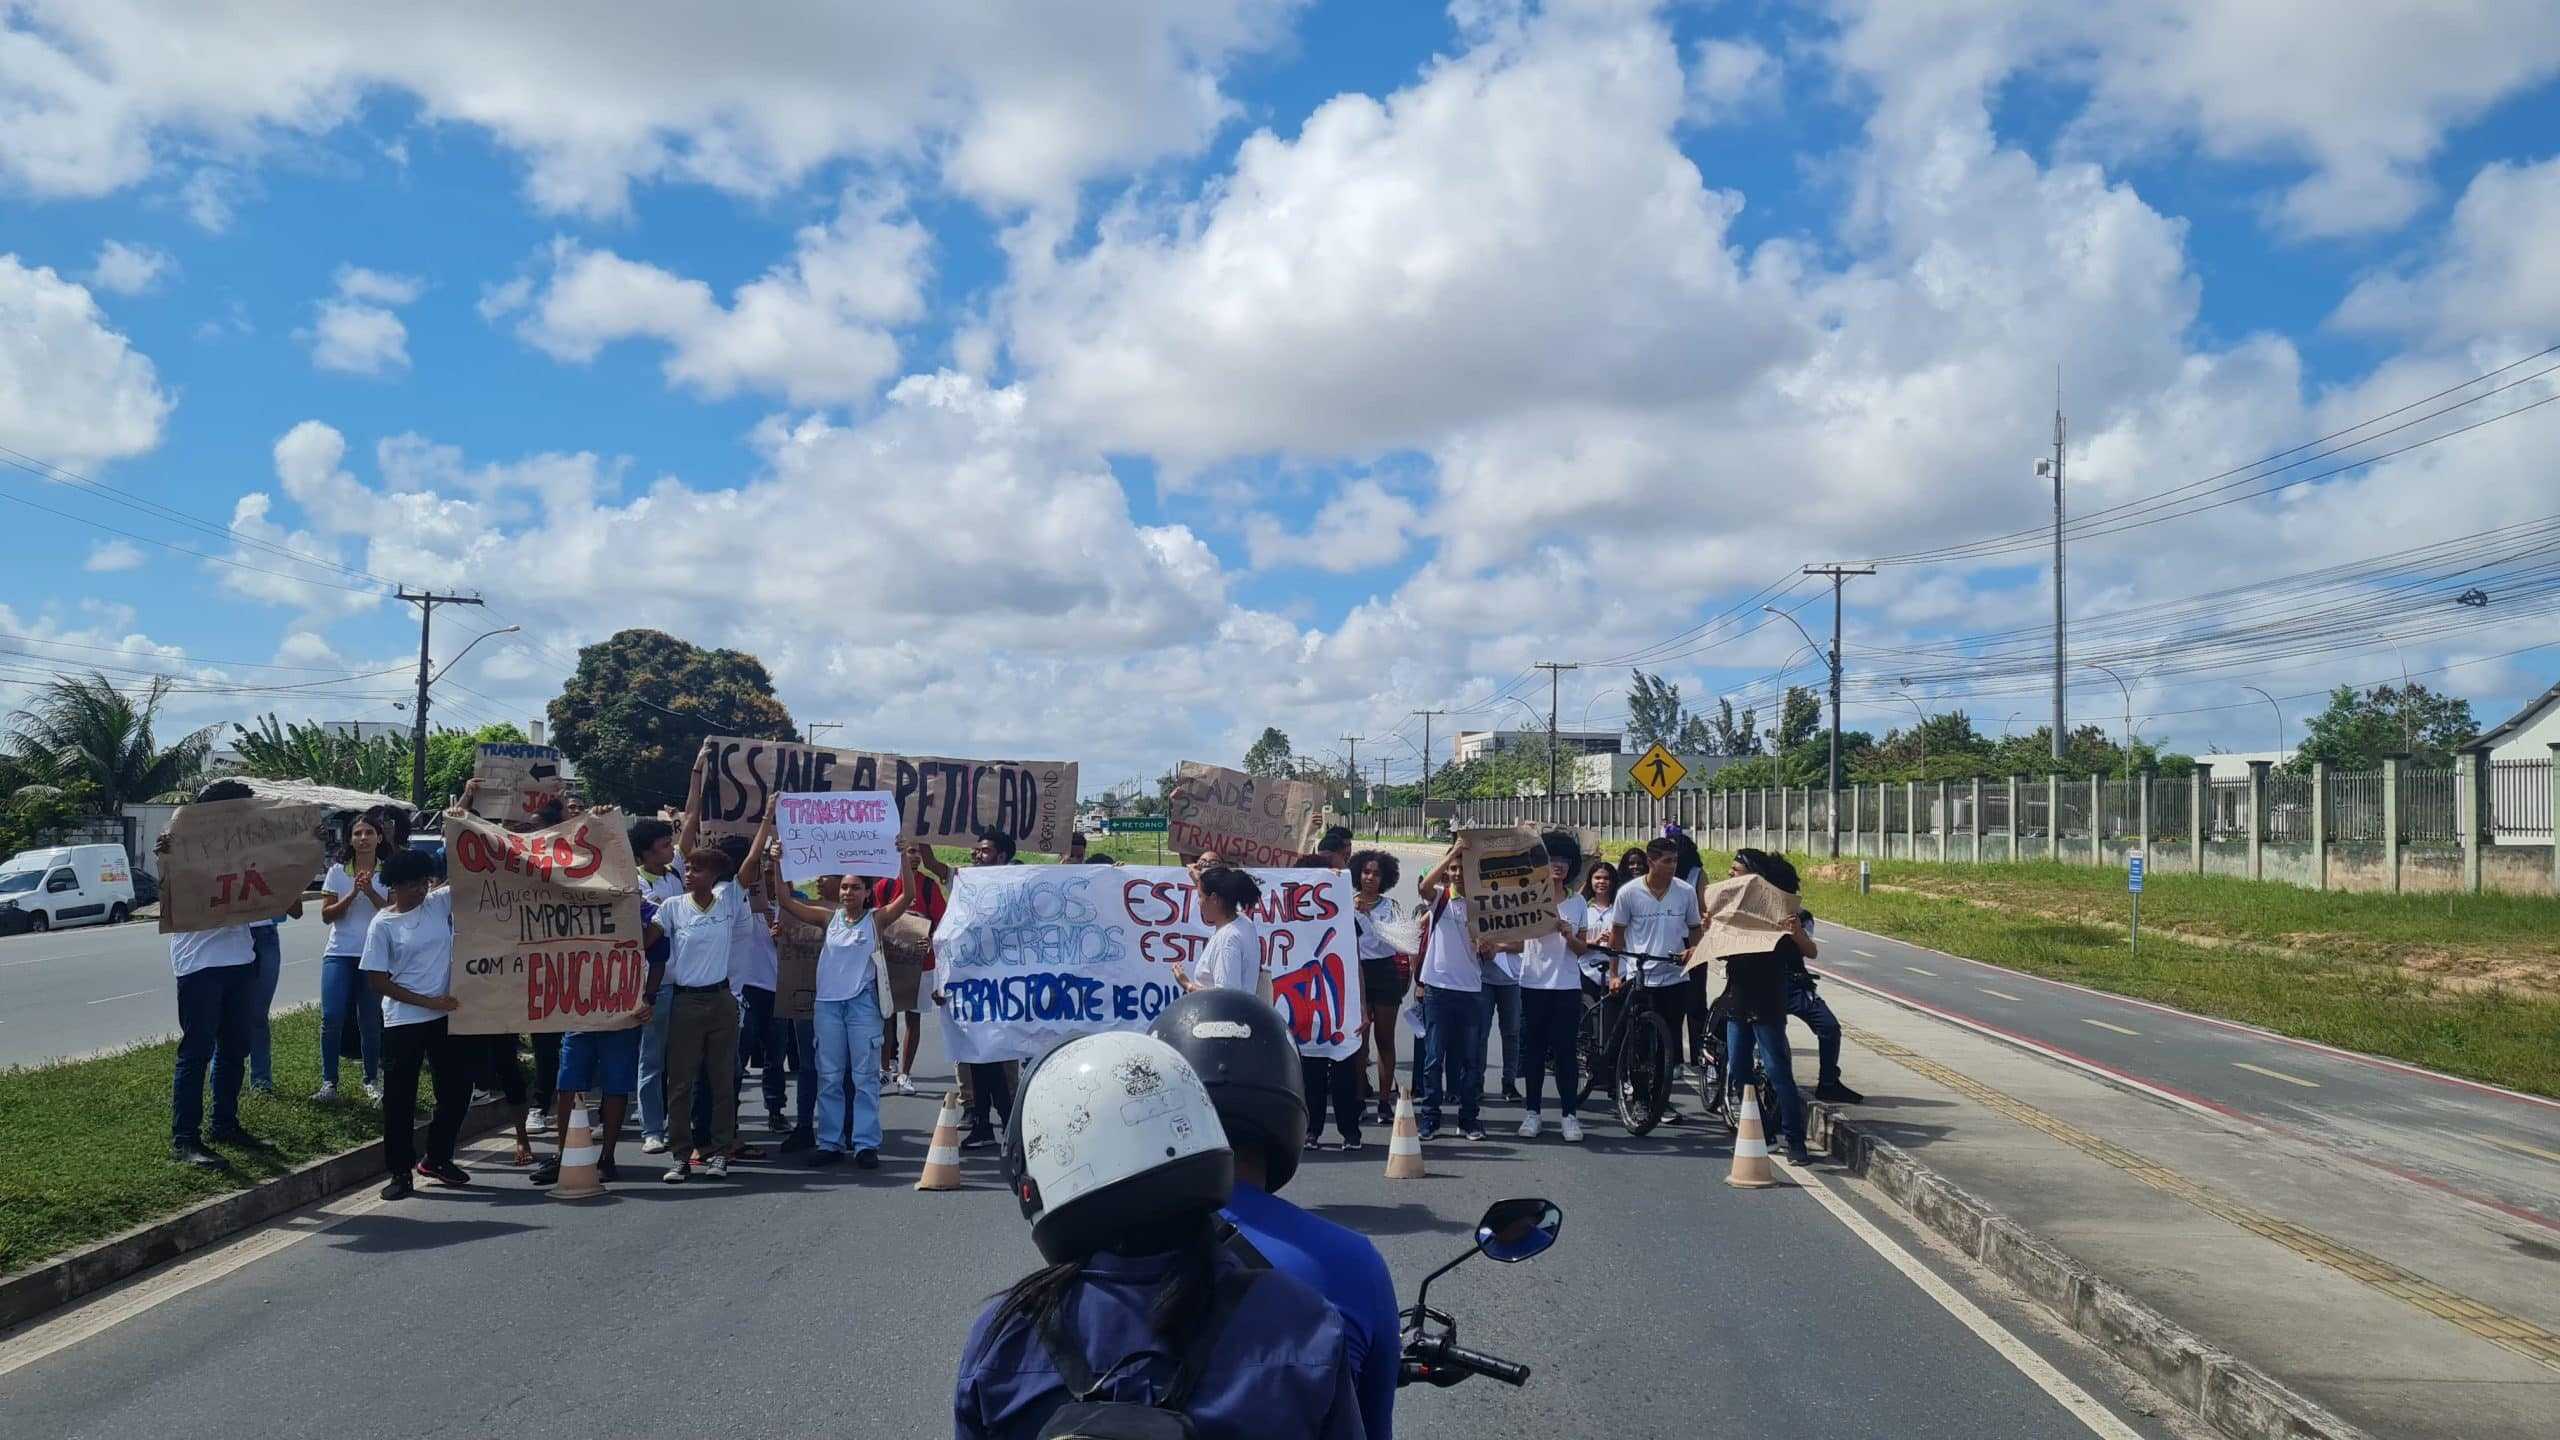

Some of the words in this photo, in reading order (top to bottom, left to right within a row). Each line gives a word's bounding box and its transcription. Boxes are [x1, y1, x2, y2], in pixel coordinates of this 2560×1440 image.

[480, 744, 559, 761] TRANSPORTE
[702, 742, 836, 825] ASSINE
[852, 757, 877, 791] A
[781, 798, 887, 824] TRANSPORTE
[1122, 821, 1164, 829] RETORNO
[787, 828, 803, 840] DE
[810, 827, 880, 845] QUALIDADE
[789, 844, 822, 865] JÁ!
[210, 863, 273, 908] JÁ
[952, 877, 1097, 925] SOMOS
[1474, 890, 1538, 911] TEMOS
[520, 903, 615, 941] IMPORTE
[946, 923, 1126, 968] QUEREMOS
[466, 957, 503, 975] COM
[513, 956, 524, 973] A
[528, 940, 641, 1021] EDUCAÇÃO
[944, 972, 1104, 1022] TRANSPORTE
[1113, 984, 1139, 1020] DE
